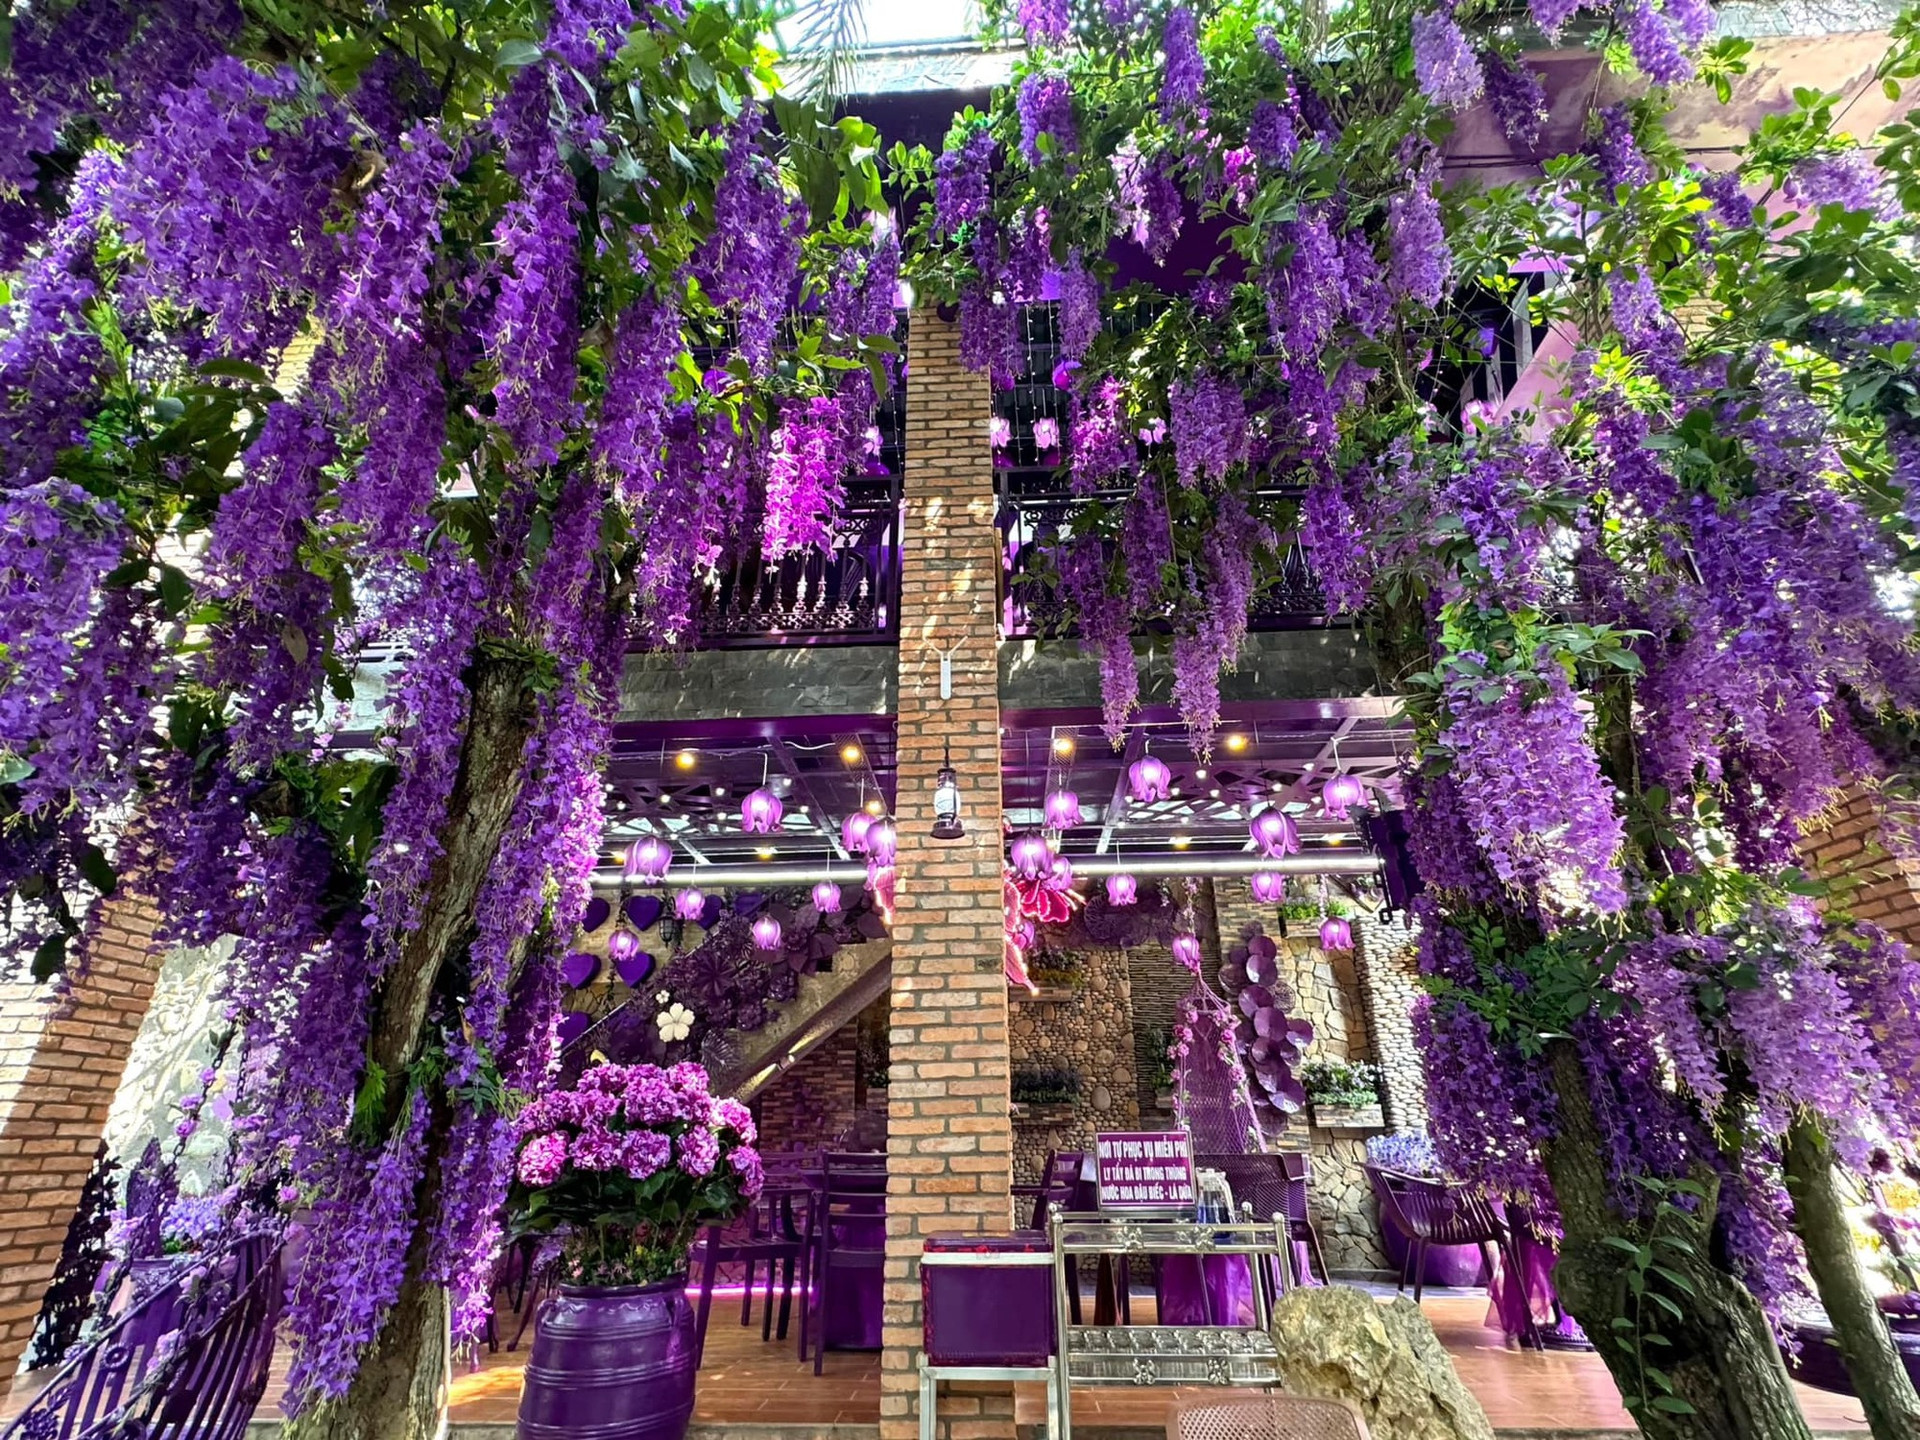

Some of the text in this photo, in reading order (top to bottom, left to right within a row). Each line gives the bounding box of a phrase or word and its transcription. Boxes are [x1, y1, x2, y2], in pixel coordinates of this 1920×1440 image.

[1123, 1141, 1142, 1161] PHỤC
[1143, 1141, 1153, 1161] VỤ
[1143, 1167, 1164, 1180] TRONG
[1120, 1186, 1133, 1200] HOA
